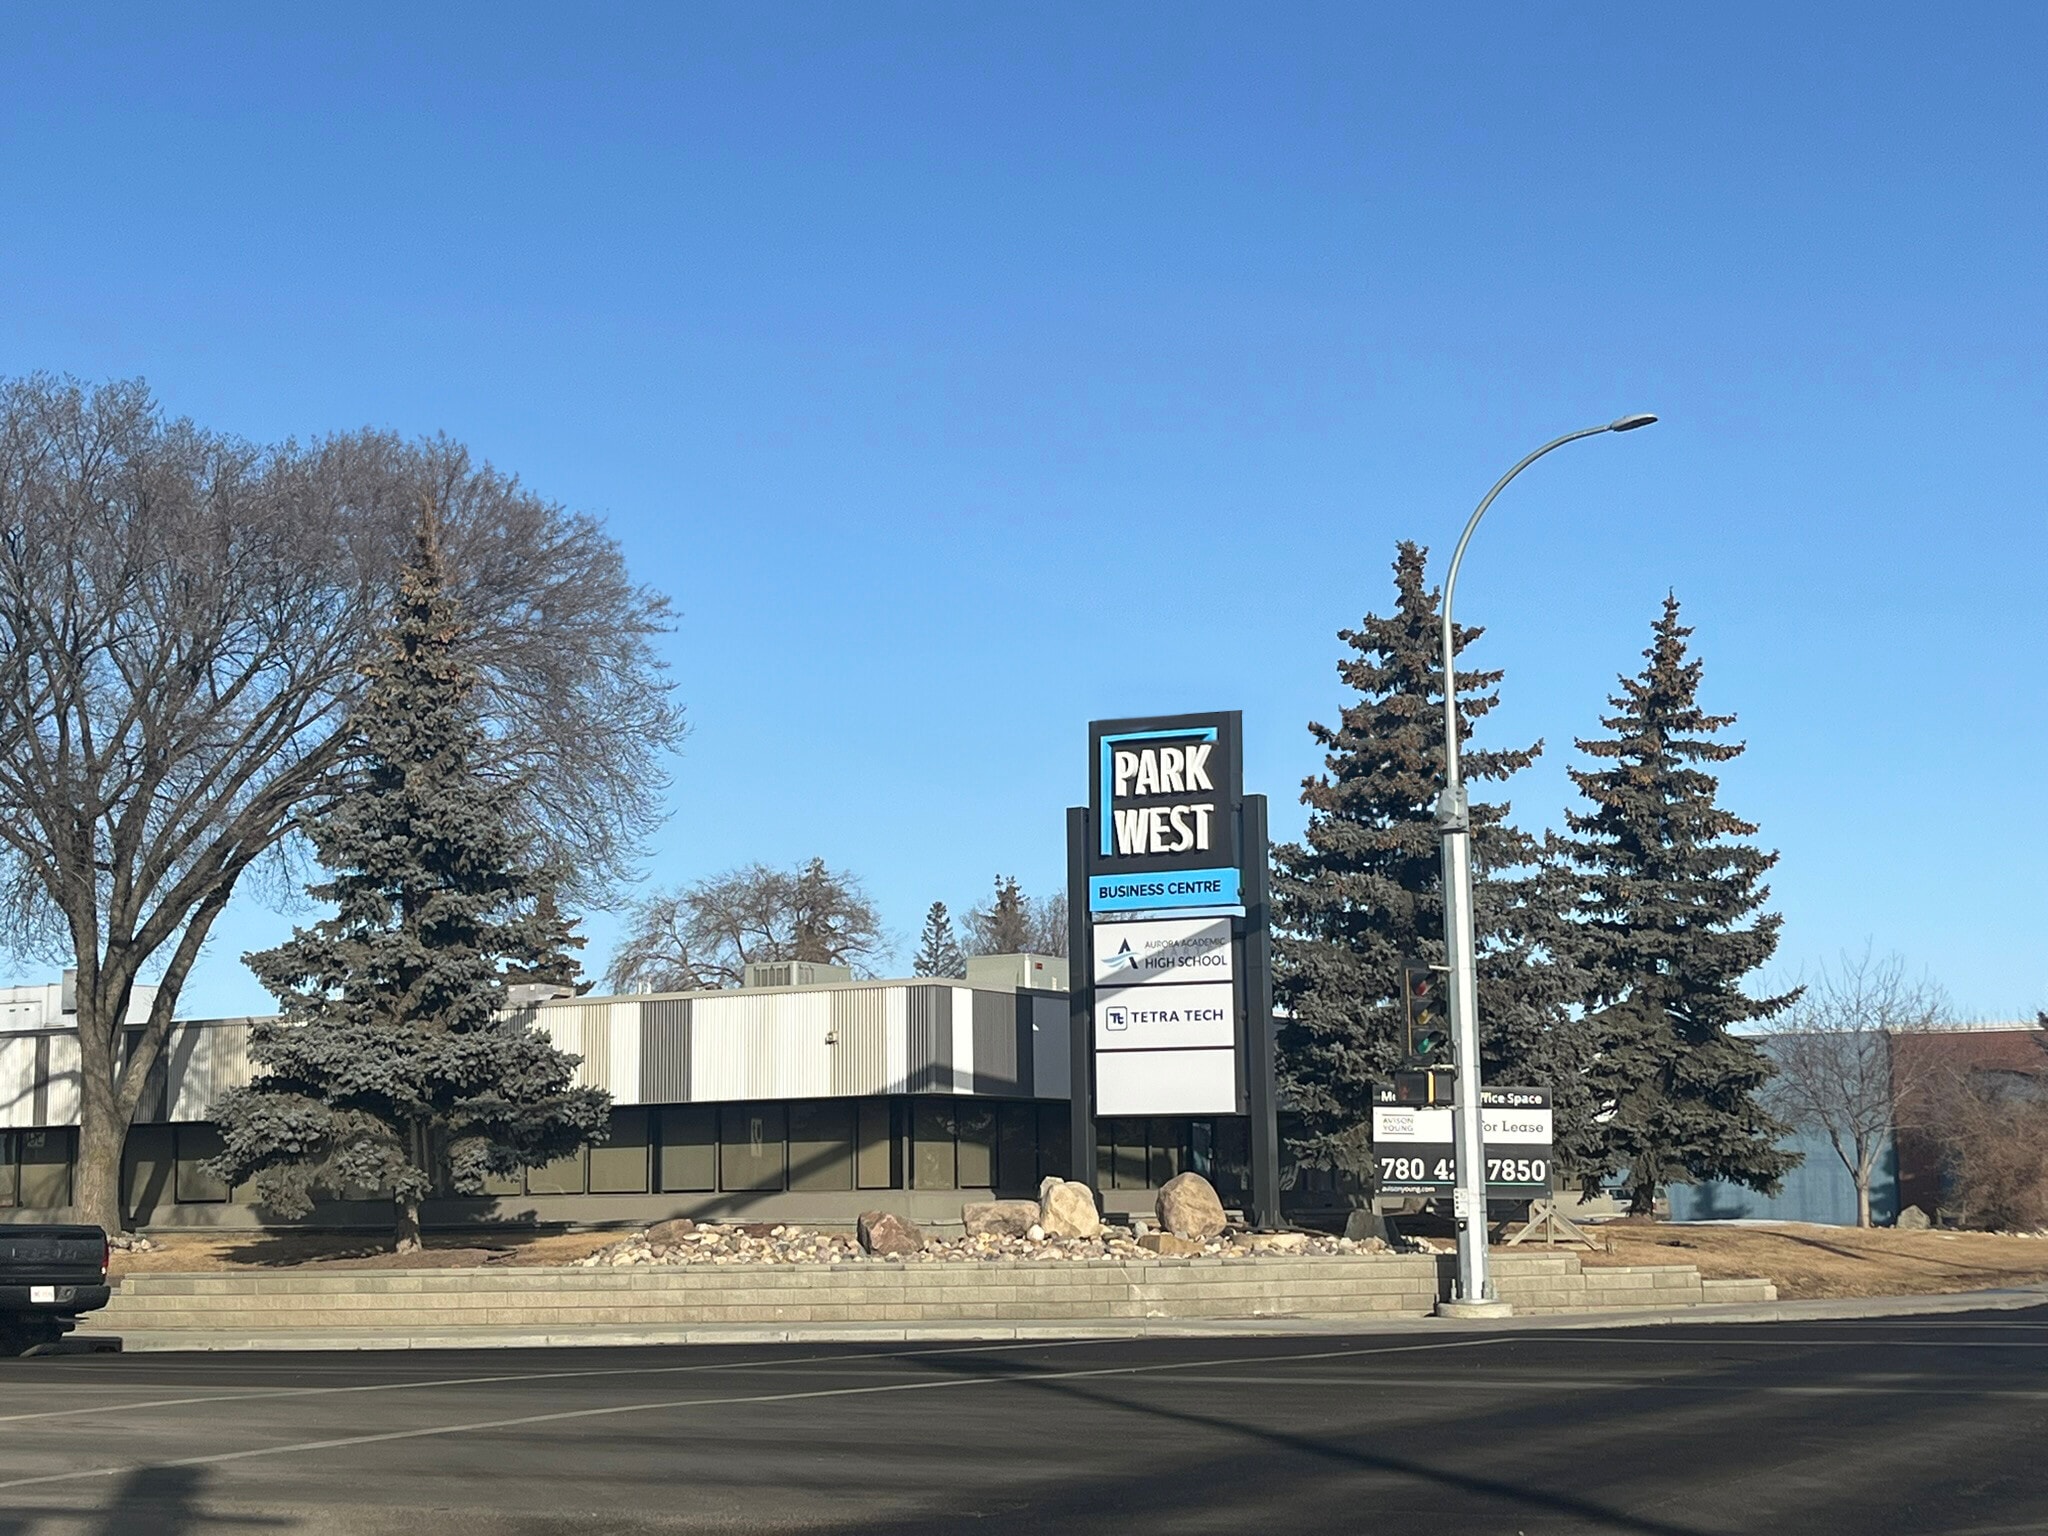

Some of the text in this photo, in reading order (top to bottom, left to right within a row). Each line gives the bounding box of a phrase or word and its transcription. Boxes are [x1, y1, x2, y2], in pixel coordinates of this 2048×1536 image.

[1114, 744, 1214, 797] PARK
[1114, 803, 1214, 855] WEST
[1099, 880, 1221, 899] BUSINESS CENTRE
[1144, 937, 1225, 949] AURORA ACADEMIC
[1145, 955, 1228, 970] HIGH SCHOOL
[1131, 1010, 1180, 1024] TETRA
[1184, 1009, 1224, 1022] TECH
[1507, 1093, 1543, 1106] Space
[1383, 1117, 1414, 1125] AVISON
[1383, 1124, 1414, 1132] YOUNG
[1502, 1121, 1544, 1133] Lease
[1381, 1158, 1425, 1180] 780
[1487, 1159, 1546, 1182] 7850
[1382, 1185, 1436, 1194] avisonyoung.com
